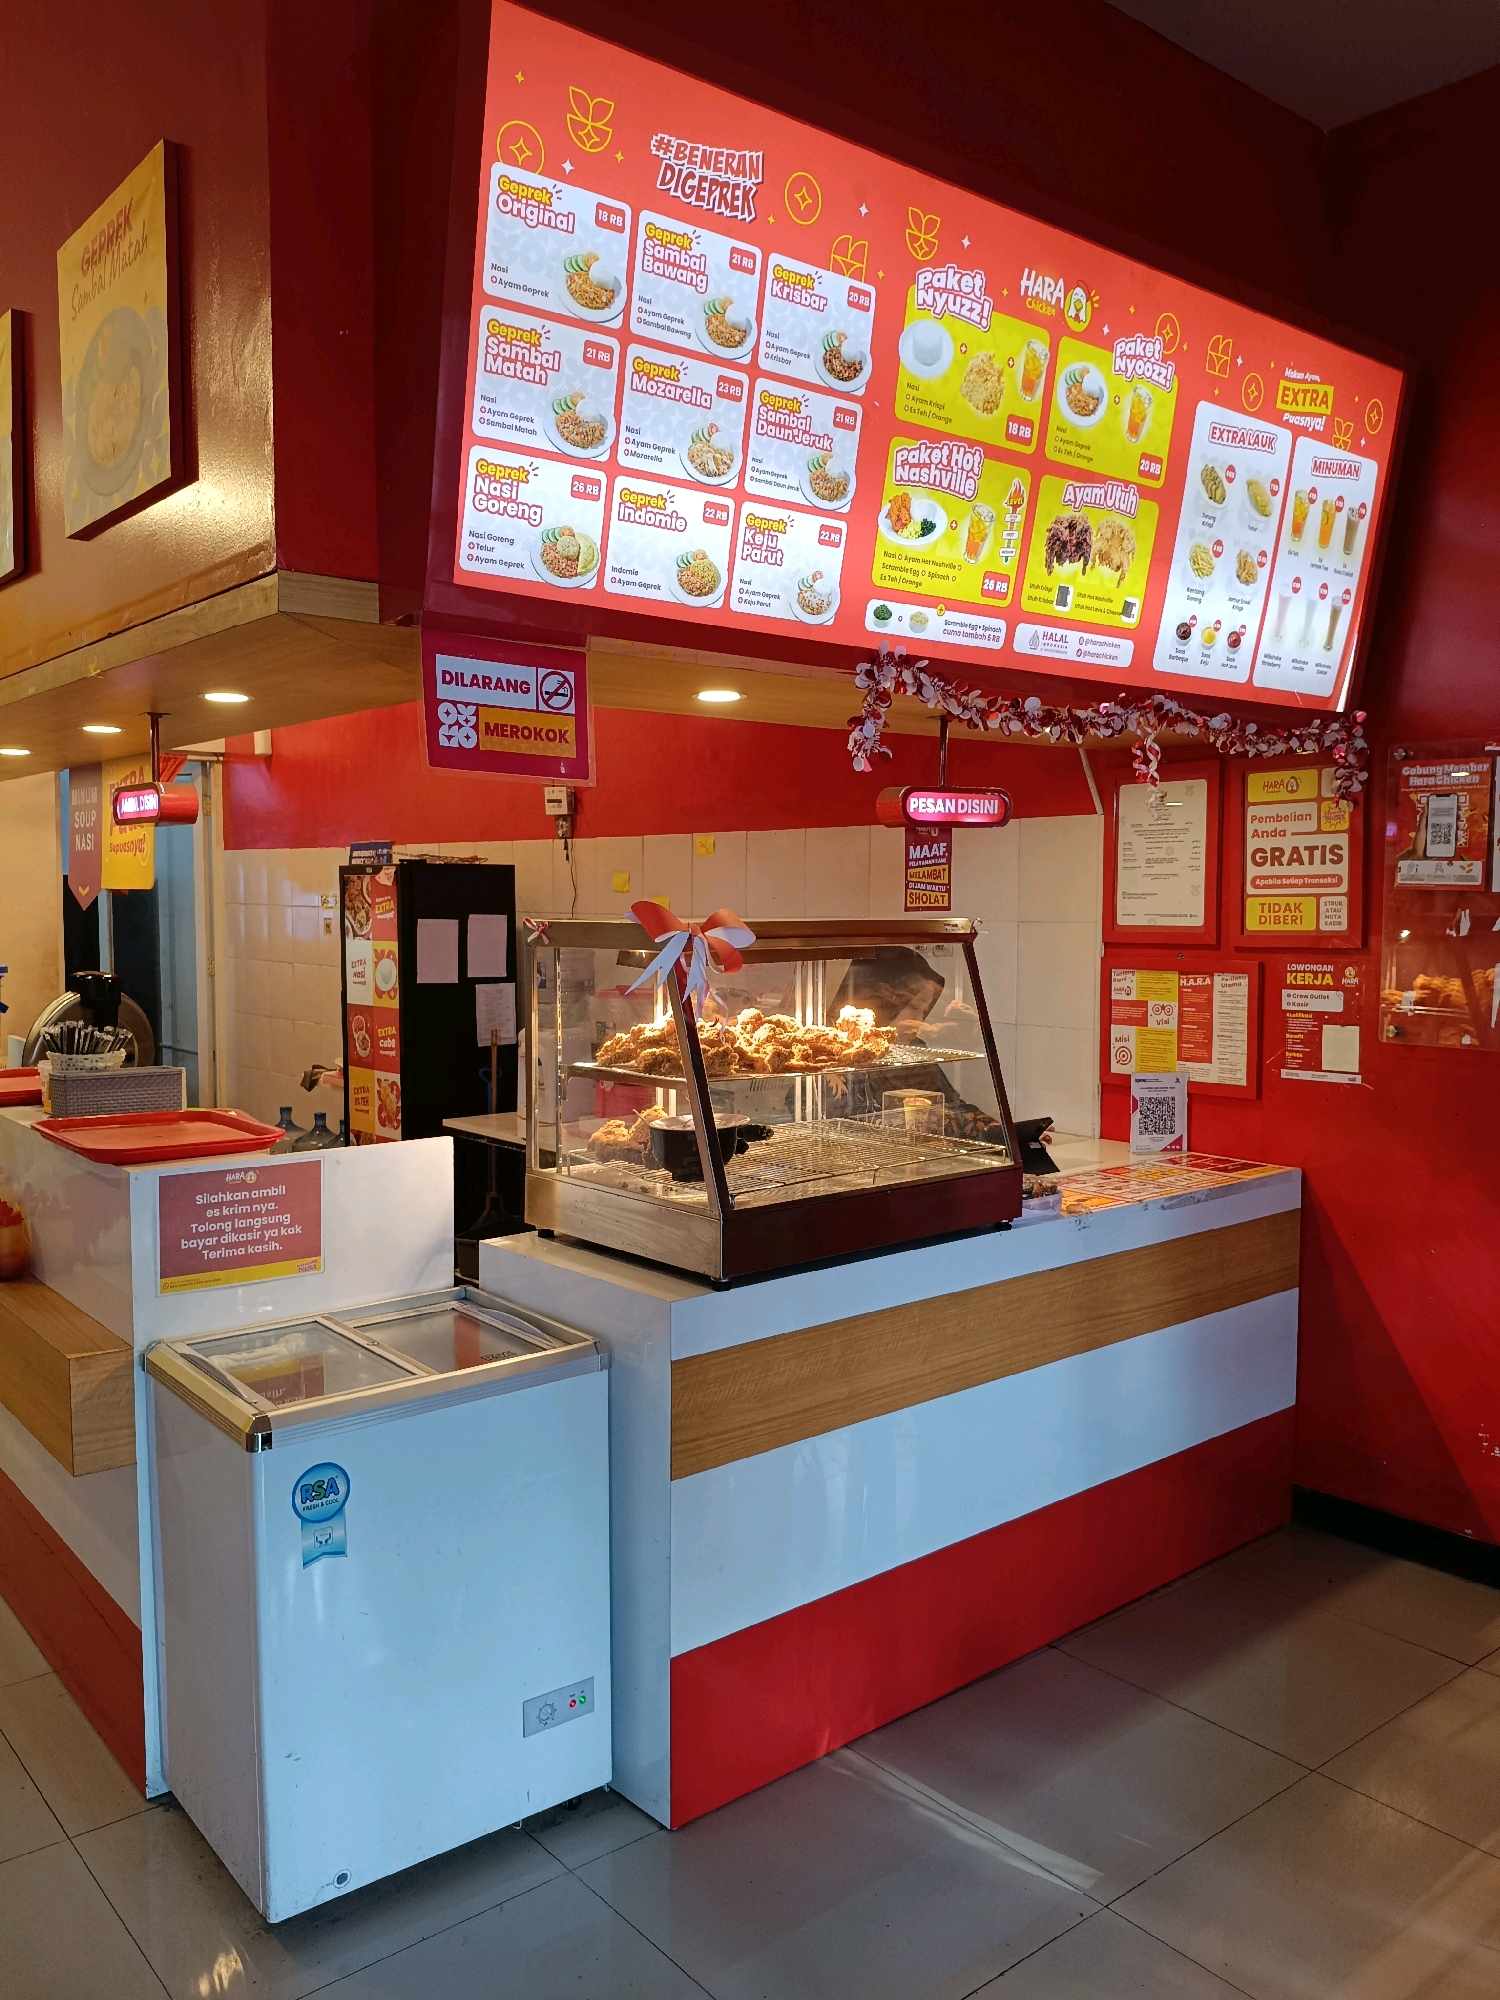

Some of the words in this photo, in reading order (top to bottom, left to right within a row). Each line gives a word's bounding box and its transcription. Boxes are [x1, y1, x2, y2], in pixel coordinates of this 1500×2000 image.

[651, 134, 764, 184] #BENERAN
[498, 176, 553, 206] Geprek
[657, 160, 757, 222] DIGEPREK
[497, 193, 575, 234] Original
[598, 210, 608, 222] 18
[609, 214, 623, 227] RB
[81, 197, 133, 278] GEPREK
[645, 222, 694, 251] Geprek
[644, 238, 706, 274] Sambal
[732, 253, 741, 265] 21
[742, 256, 754, 269] RB
[71, 255, 107, 322] Sambal
[109, 219, 148, 287] Matah
[491, 262, 509, 274] Nasi
[642, 254, 708, 294] Bawang
[773, 264, 816, 291] Geprek
[498, 278, 521, 291] Ayam
[522, 284, 550, 298] Geprek
[917, 265, 986, 300] Paket
[1020, 267, 1065, 310] HARA
[771, 278, 828, 312] Krisbar
[848, 291, 858, 302] 20
[916, 290, 993, 331] Nyuzz!
[1025, 297, 1056, 317] Chicken
[487, 318, 542, 347] Geprek
[486, 334, 561, 373] Sambal
[586, 347, 596, 359] 21
[597, 351, 611, 363] RB
[1114, 335, 1162, 361] Paket
[484, 352, 548, 386] Matah
[633, 356, 680, 382] Geprek
[1113, 356, 1174, 392] Nyoozz!
[631, 371, 713, 410] Mozarella
[718, 381, 729, 393] 23
[730, 386, 742, 397] RB
[1281, 386, 1328, 410] EXTRA
[480, 394, 497, 404] Nasi
[760, 390, 802, 414] Geprek
[486, 408, 509, 420] Ayam
[509, 411, 535, 424] Geprek
[758, 405, 812, 433] Sambal
[1283, 413, 1326, 432] Puasnya!
[486, 419, 514, 431] Sambal
[514, 424, 538, 436] Matah
[625, 425, 641, 436] Nasi
[756, 419, 794, 443] Daun
[793, 427, 833, 452] Jeruk
[1008, 421, 1019, 435] 18
[1019, 425, 1032, 438] RB
[631, 439, 652, 451] Ayam
[652, 443, 676, 455] Geprek
[1209, 423, 1246, 446] EXTRA
[1246, 430, 1276, 452] LAUK
[895, 442, 951, 468] Paket
[951, 442, 984, 478] Hot
[1140, 459, 1149, 471] 20
[1150, 462, 1162, 475] RB
[1312, 458, 1360, 479] MINUMAN
[476, 458, 530, 484] Geprek
[474, 474, 519, 501] Nasi
[572, 481, 584, 492] 26
[585, 484, 599, 496] RB
[894, 464, 978, 502] Nashville
[620, 487, 668, 511] Geprek
[1063, 482, 1105, 512] Ayam
[1104, 482, 1139, 517] Utuh
[472, 494, 543, 528] Goreng
[618, 502, 688, 533] Indomie
[705, 508, 715, 518] 22
[715, 510, 728, 521] RB
[746, 513, 787, 534] Geprek
[469, 530, 486, 541] Nasi
[486, 533, 515, 546] Goreng
[744, 527, 778, 551] Keju
[474, 555, 497, 567] Ayam
[498, 559, 525, 571] Geprek
[741, 543, 784, 567] Parut
[881, 562, 909, 575] Scramble
[983, 579, 994, 591] 26
[995, 581, 1008, 593] RB
[1042, 630, 1069, 645] HALAL
[441, 669, 531, 695] DILARANG
[484, 721, 570, 744] MEROKOK
[1402, 765, 1443, 777] Gabung
[1262, 778, 1285, 792] HARA
[1408, 775, 1436, 787] Hara
[71, 785, 98, 806] MINUM
[909, 797, 956, 813] PESAN
[957, 799, 999, 814] DISINI
[74, 810, 97, 829] SOUP
[1250, 811, 1312, 825] Pembelian
[75, 833, 94, 851] NASI
[1250, 828, 1287, 839] Anda
[909, 842, 947, 860] MAAF
[1250, 844, 1344, 868] GRATIS
[909, 868, 946, 880] MELAMBAT
[1255, 877, 1281, 887] Apabila
[1281, 877, 1303, 887] Setiap
[1303, 875, 1338, 885] Transaksi
[926, 884, 946, 892] WAKTU
[375, 900, 395, 914] EXTRA
[908, 892, 946, 905] SHOLAT
[1258, 902, 1303, 914] TIDAK
[1258, 914, 1303, 926] DIBERI
[351, 958, 367, 969] EXTRA
[1287, 963, 1334, 972] LOWONGAN
[1180, 977, 1211, 986] H.A.R.A
[1220, 981, 1242, 989] Utama
[1286, 972, 1334, 986] KERJA
[1341, 977, 1359, 985] HARA
[378, 1025, 397, 1037] EXTRA
[1156, 1017, 1170, 1026] Visi
[379, 1037, 396, 1048] cabe
[1114, 1034, 1130, 1043] Misi
[353, 1085, 370, 1095] EXTRA
[225, 1171, 245, 1182] HARA
[195, 1189, 249, 1205] Silahkan
[250, 1185, 286, 1199] ambil
[206, 1208, 220, 1218] es
[222, 1204, 251, 1216] krim
[252, 1202, 279, 1214] nya.
[190, 1220, 232, 1235] Tolong
[234, 1212, 291, 1229] langsung
[181, 1235, 219, 1250] bayar
[220, 1229, 261, 1244] dikasir
[263, 1228, 279, 1239] ya
[280, 1224, 302, 1236] kak
[201, 1247, 245, 1260] Terima
[247, 1240, 283, 1254] kasih.
[300, 1477, 340, 1504] RSA
[302, 1502, 320, 1512] FRESH
[325, 1498, 340, 1506] COOL
